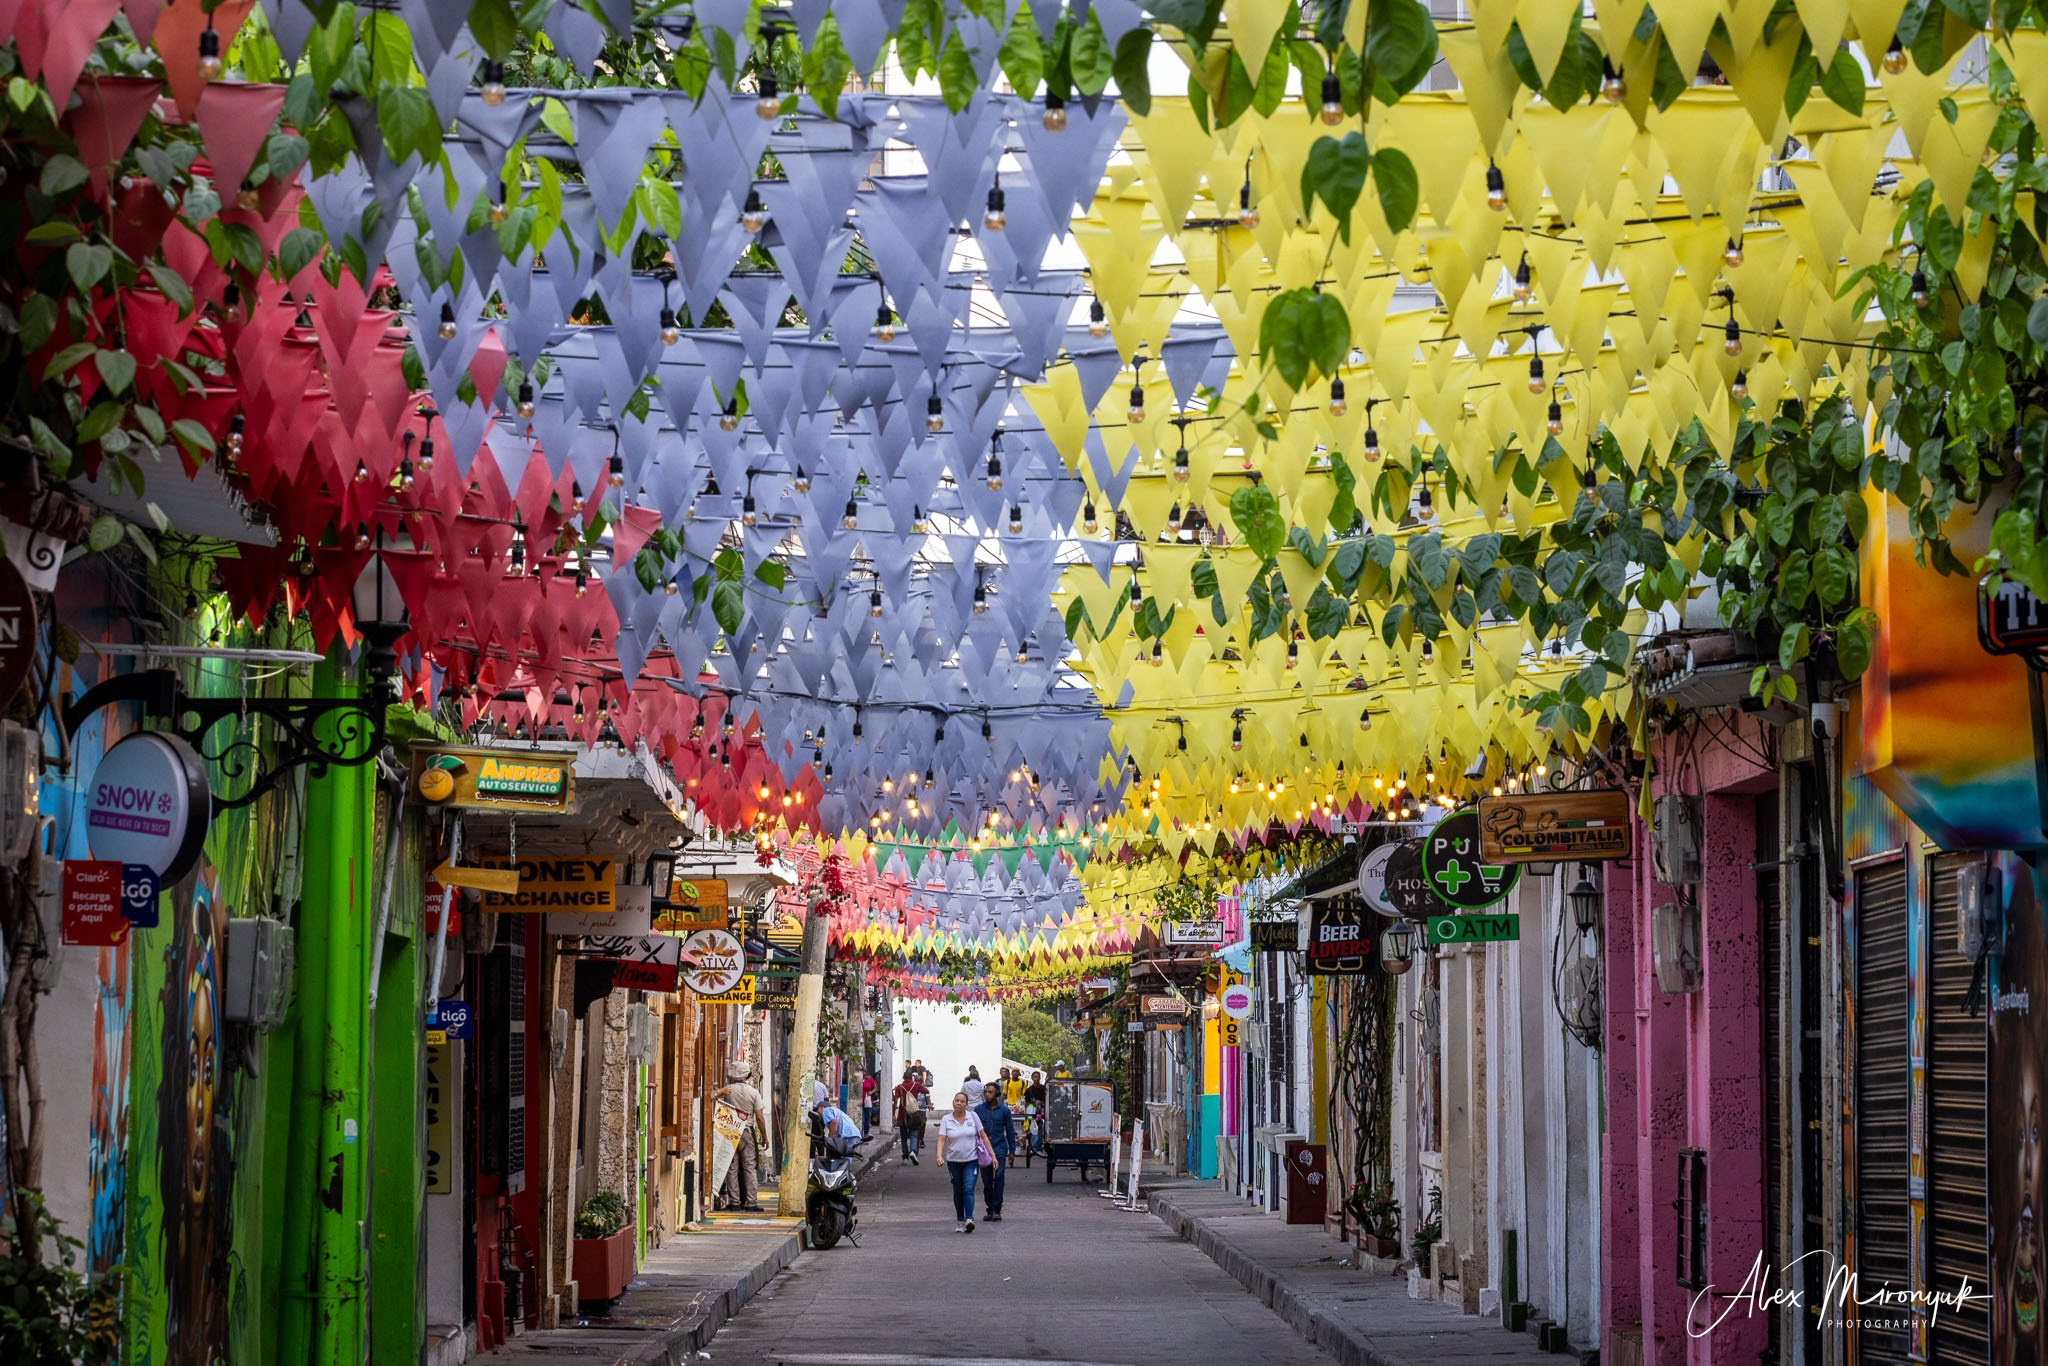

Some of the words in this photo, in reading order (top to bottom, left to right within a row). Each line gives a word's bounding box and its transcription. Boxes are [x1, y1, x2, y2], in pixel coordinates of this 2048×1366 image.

[480, 759, 560, 783] ANDRES
[479, 780, 557, 793] AUTOSERVICIO
[96, 784, 155, 812] SNOW
[1502, 828, 1623, 846] COLOMBITALIA
[76, 869, 109, 882] Claro
[72, 891, 110, 903] Recarga
[485, 891, 611, 906] EXCHANGE
[427, 904, 441, 914] aqu
[590, 914, 618, 931] punto
[1462, 918, 1511, 938] ATM
[1320, 924, 1360, 942] BEER
[1311, 938, 1371, 959] LOVERS
[698, 957, 738, 968] ATIVA
